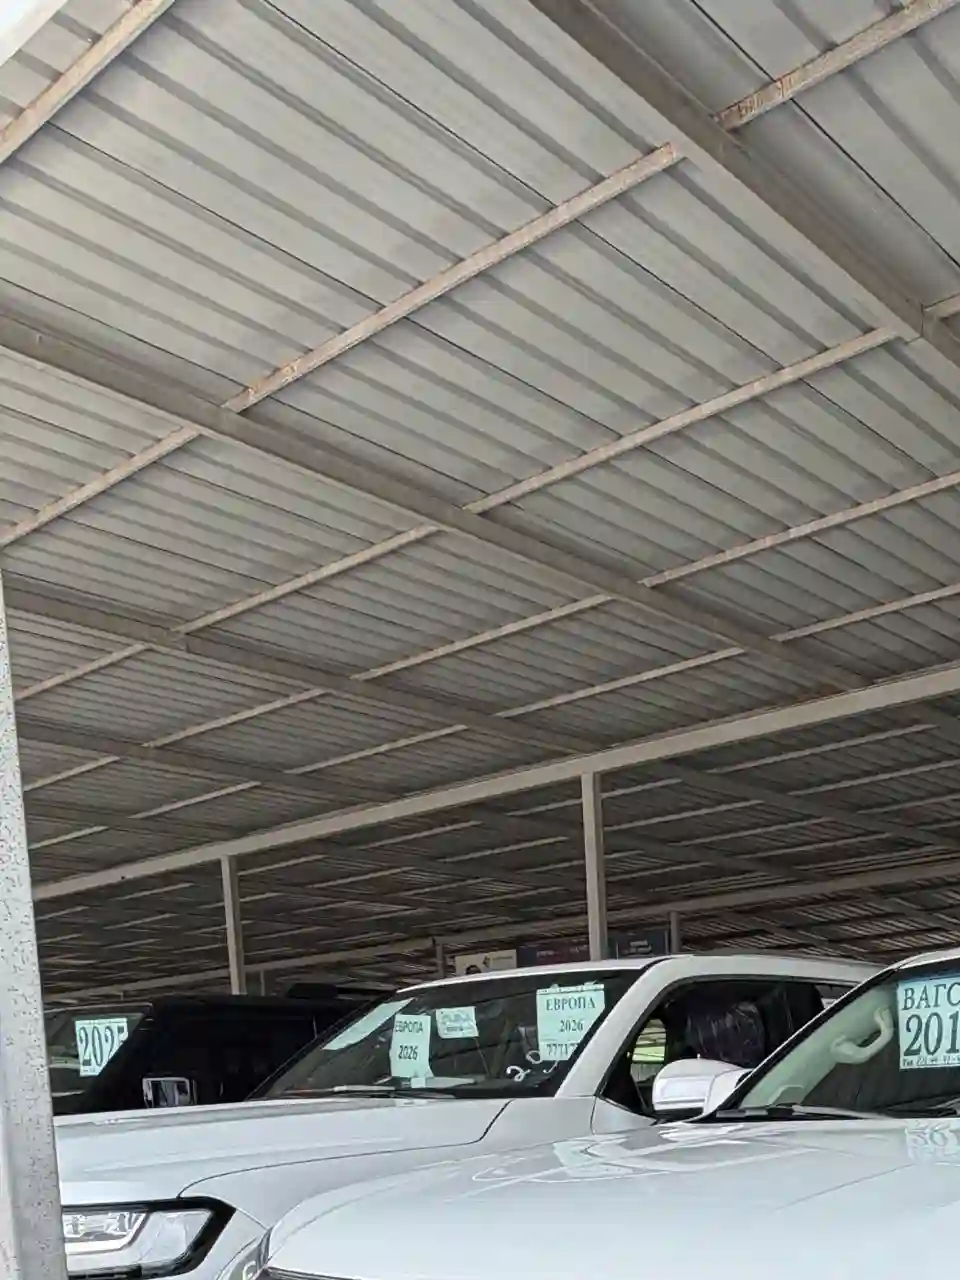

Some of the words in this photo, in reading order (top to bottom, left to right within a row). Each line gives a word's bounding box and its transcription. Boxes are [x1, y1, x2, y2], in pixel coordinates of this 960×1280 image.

[546, 996, 596, 1011] ЕВРОПА
[559, 1019, 584, 1033] 2026
[398, 1044, 418, 1061] 2026
